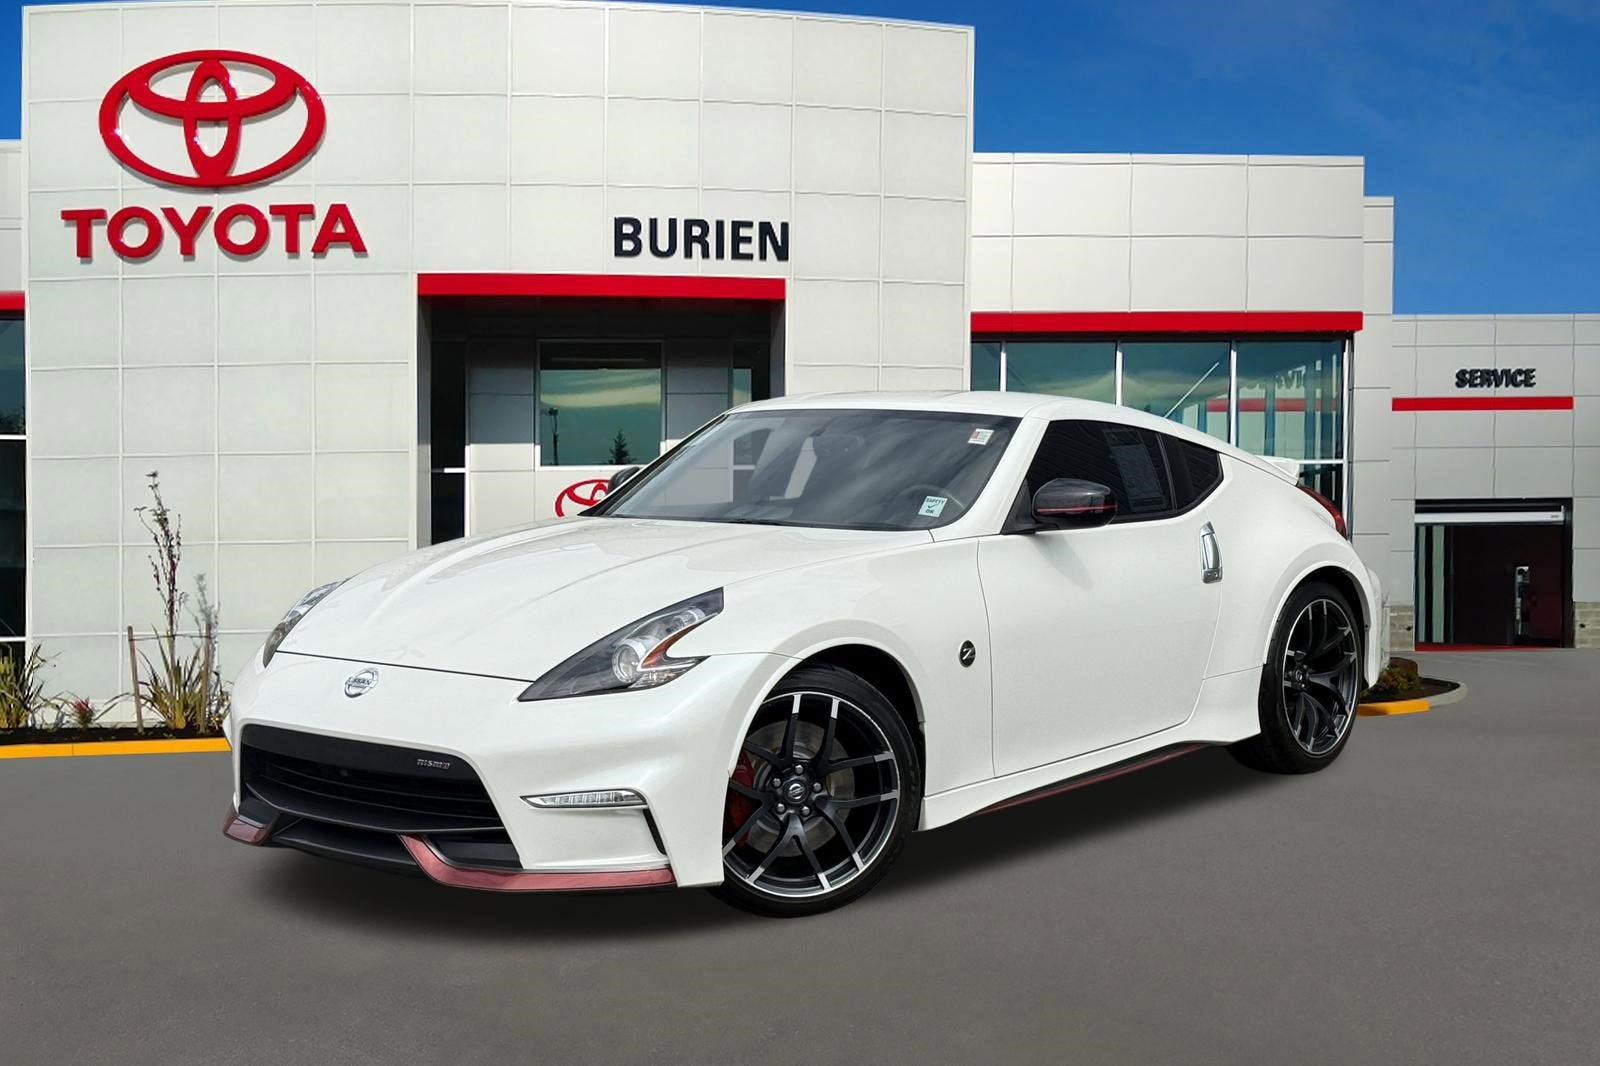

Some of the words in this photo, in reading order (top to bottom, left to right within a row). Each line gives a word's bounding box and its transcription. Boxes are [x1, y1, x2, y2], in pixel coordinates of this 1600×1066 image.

[60, 203, 367, 258] TOYOTA
[614, 216, 790, 262] BURIEN
[1455, 368, 1537, 388] SERVICE
